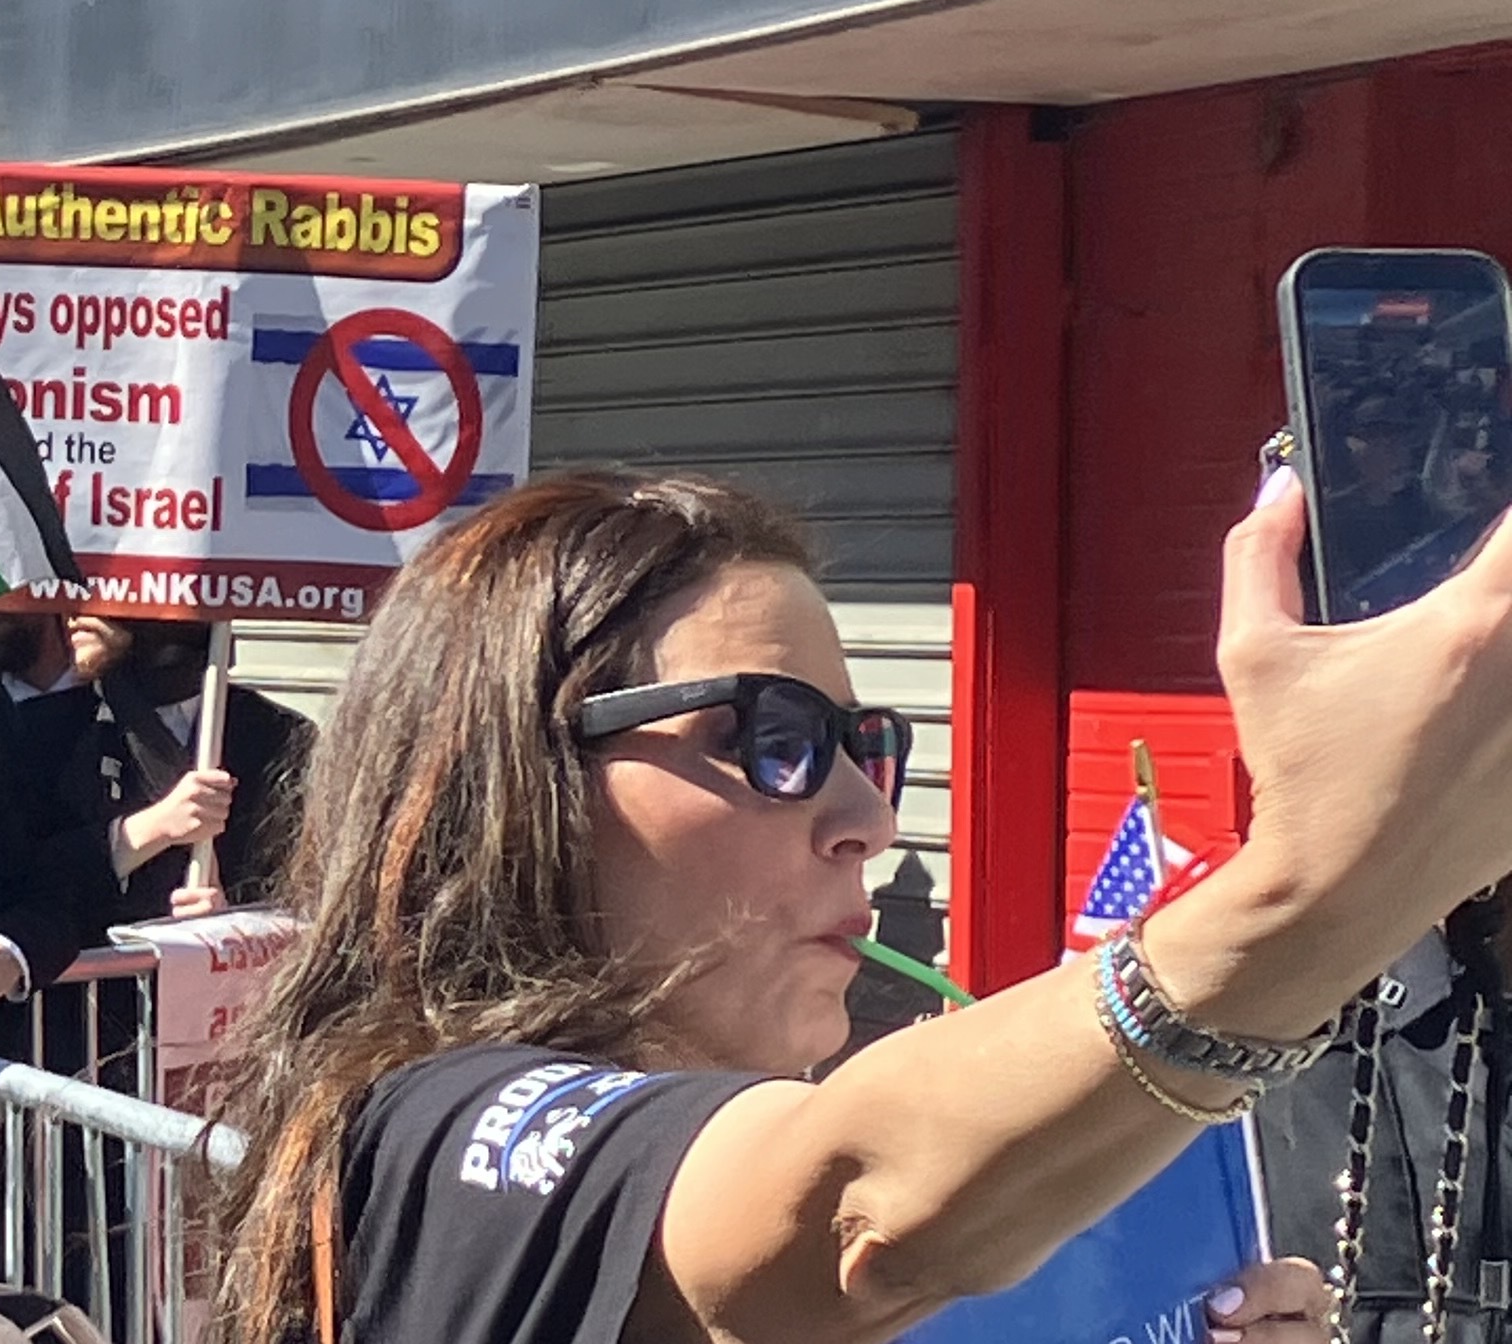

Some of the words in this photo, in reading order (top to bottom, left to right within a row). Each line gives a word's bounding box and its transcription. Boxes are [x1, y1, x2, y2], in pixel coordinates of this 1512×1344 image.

[249, 188, 441, 258] Rabbis
[48, 285, 231, 351] opposed
[64, 433, 117, 465] the
[91, 471, 224, 533] Israel
